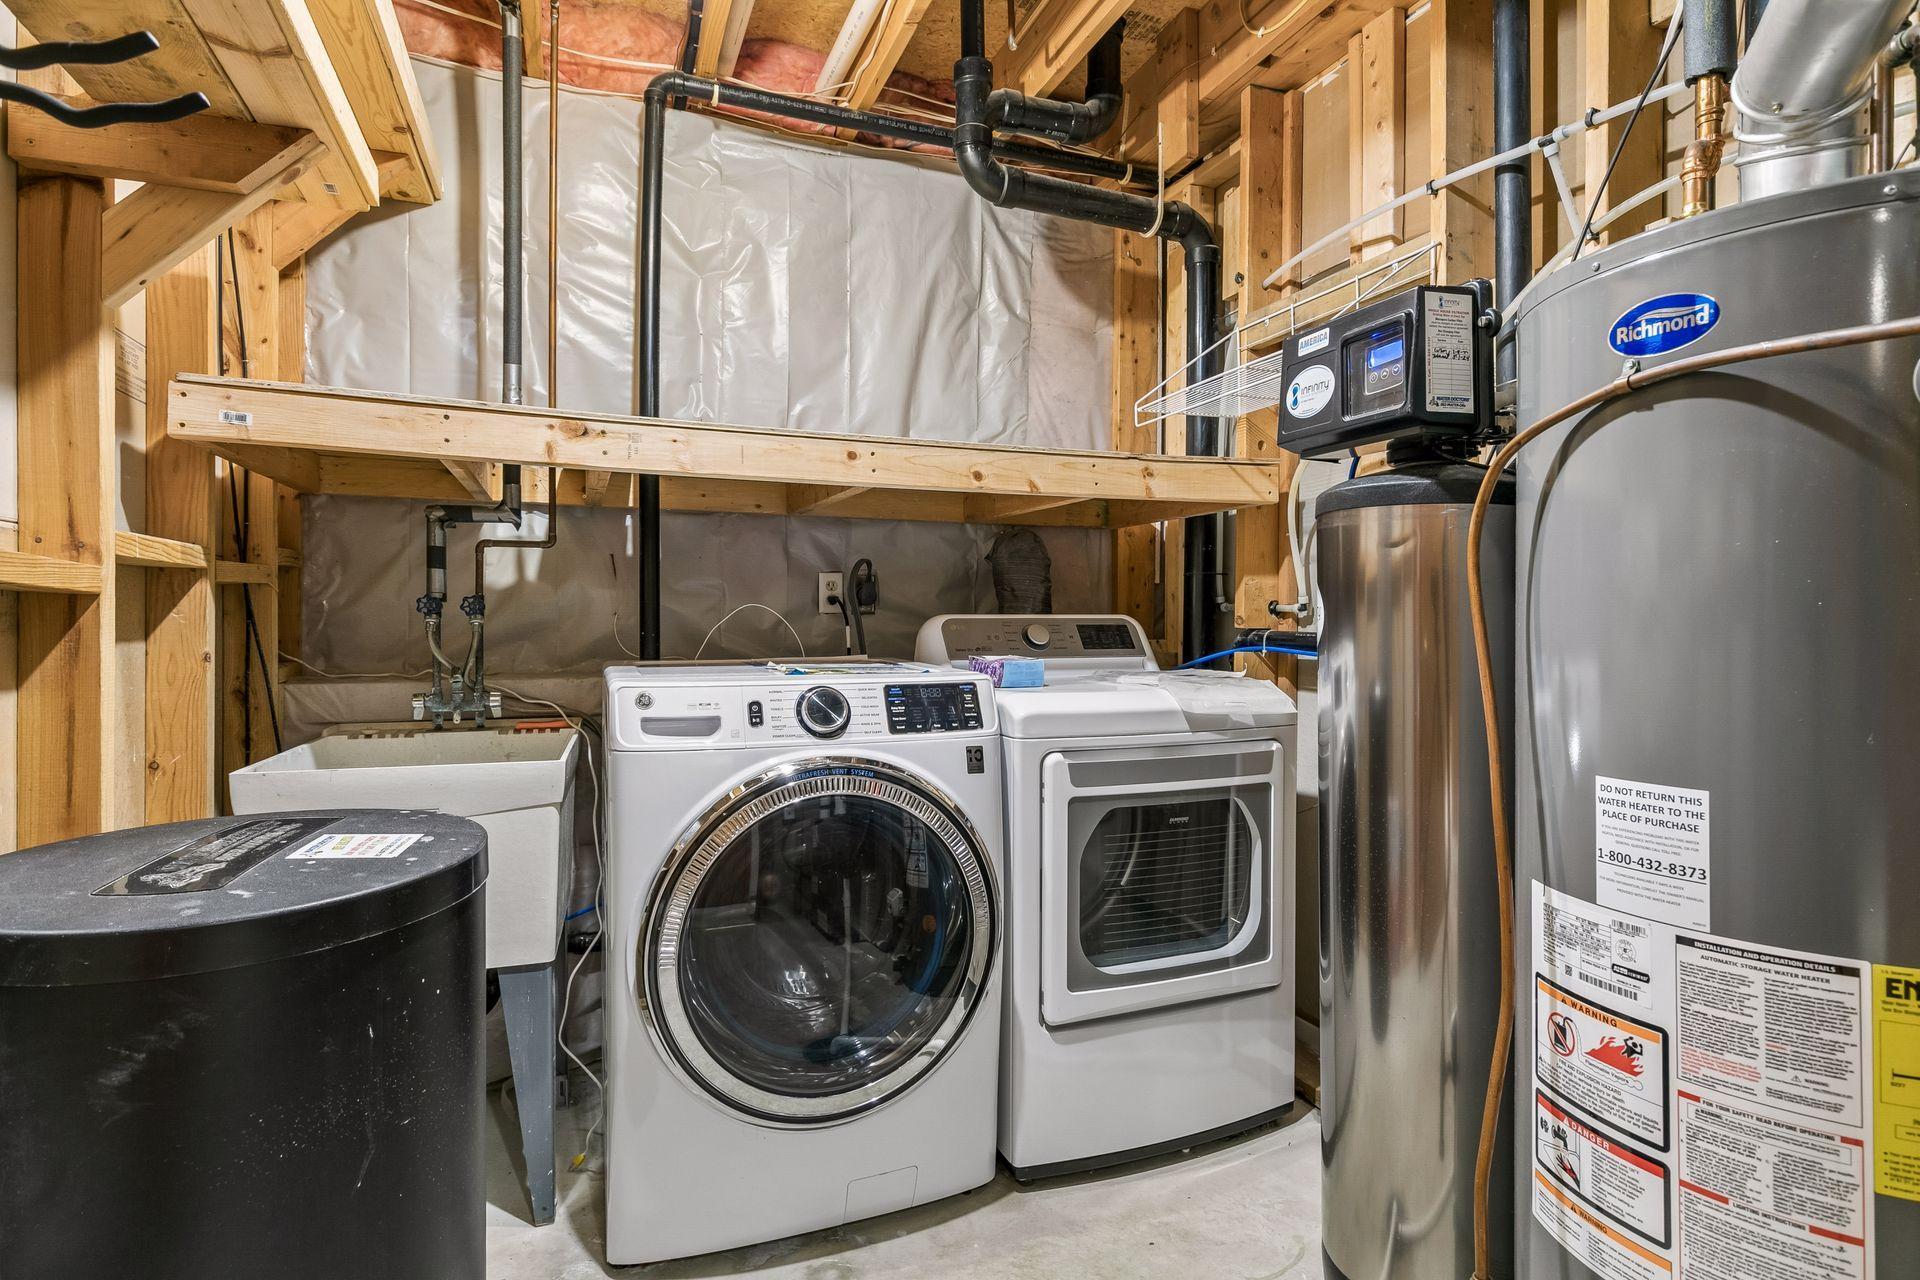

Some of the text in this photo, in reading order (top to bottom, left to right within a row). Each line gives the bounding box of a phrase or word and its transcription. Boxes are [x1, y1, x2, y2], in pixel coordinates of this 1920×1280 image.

[1616, 303, 1710, 345] Richmond
[1299, 331, 1328, 350] AMERICA
[850, 768, 874, 778] SYSTEM
[1598, 795, 1706, 821] WATER HEATER TO THE
[1600, 784, 1703, 807] DO NOT RETURN THIS
[1602, 809, 1700, 834] PLACE OF PURCHASE
[1598, 848, 1707, 881] 1-800-432-8373
[1694, 941, 1836, 973] INSTALLATION AND OPERATION DETAILS
[1700, 954, 1831, 985] AUTOMATIC STORAGE WATER HEATER
[1571, 1000, 1618, 1028] WARNING
[1702, 1100, 1836, 1142] FOR YOUR SAFETY READ BEFORE OPERATING
[1571, 1122, 1610, 1151] DANGER
[1578, 1210, 1608, 1235] WARNING
[1733, 1202, 1806, 1231] LIGHTING INSTRUCTIONS
